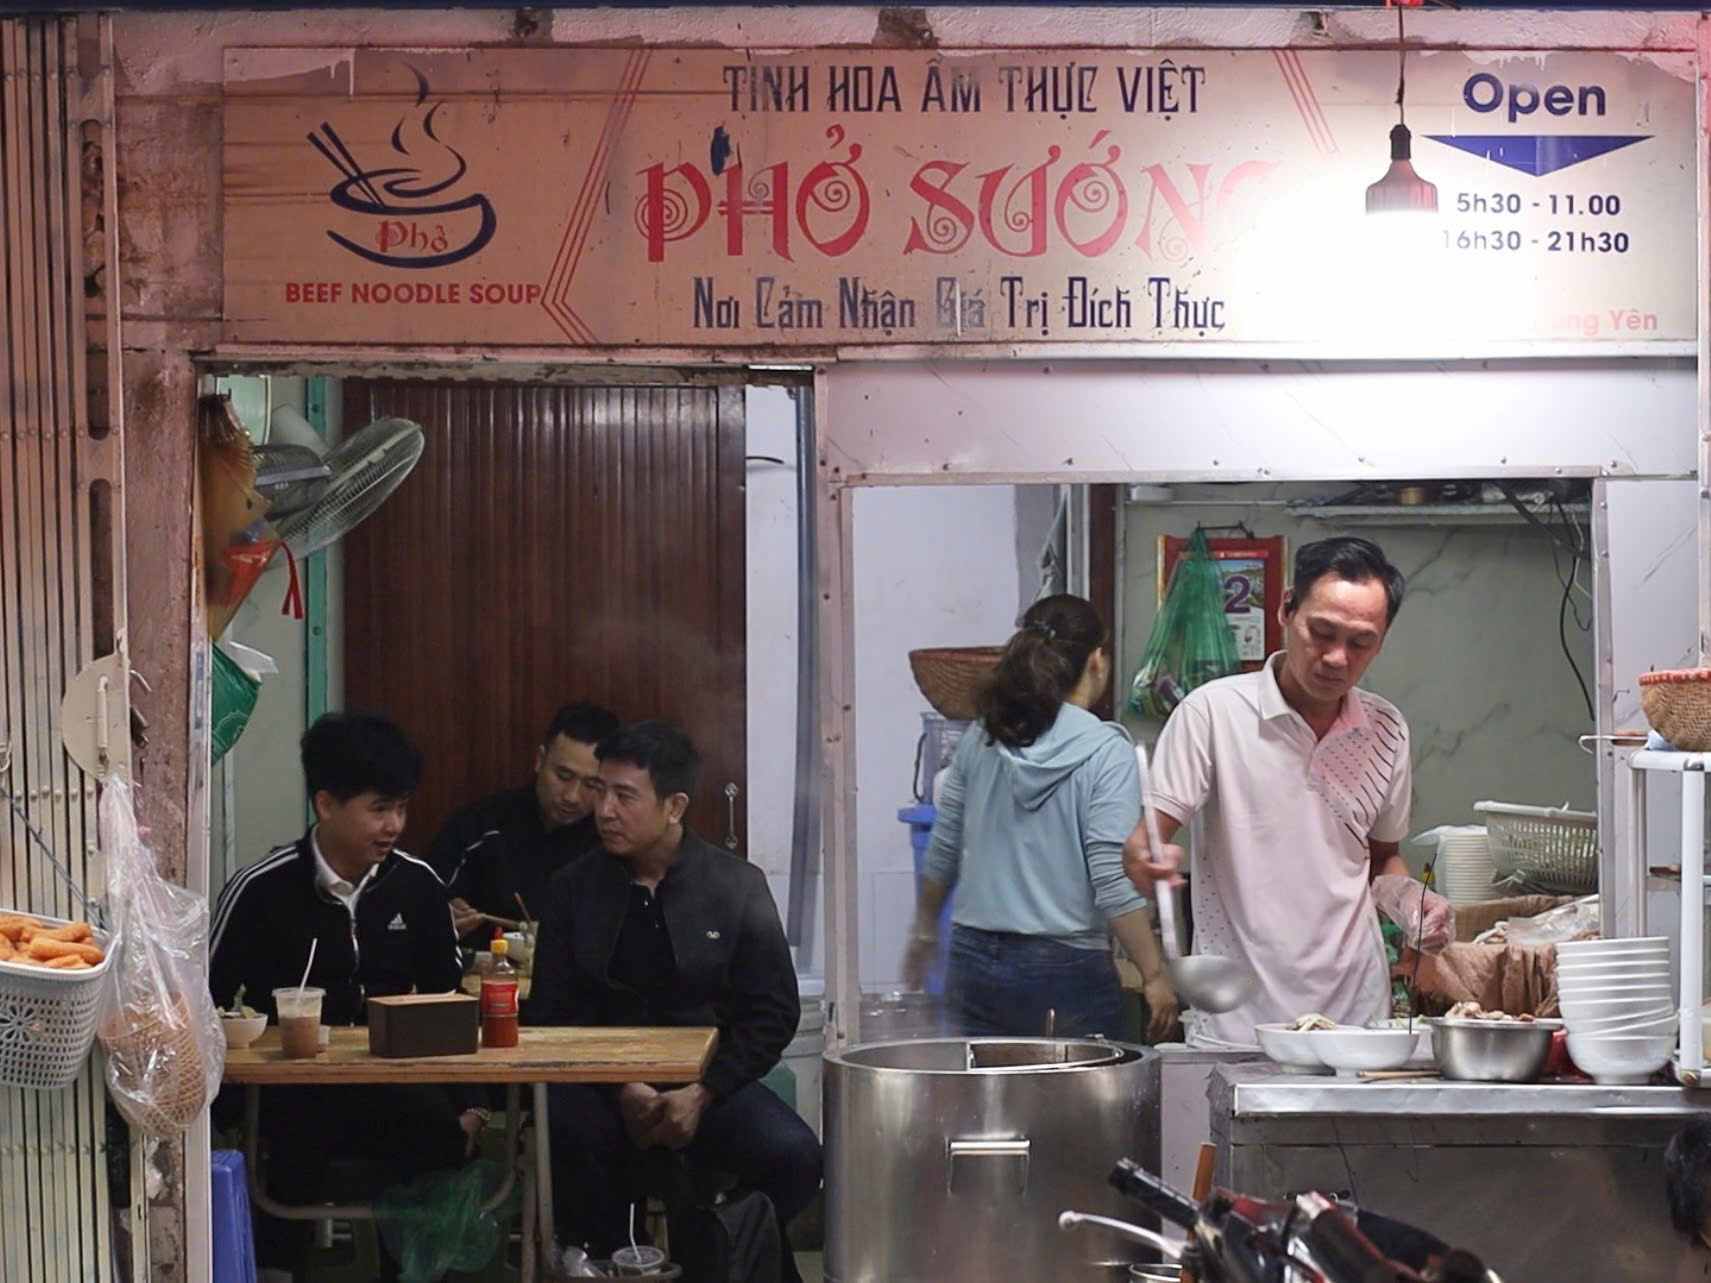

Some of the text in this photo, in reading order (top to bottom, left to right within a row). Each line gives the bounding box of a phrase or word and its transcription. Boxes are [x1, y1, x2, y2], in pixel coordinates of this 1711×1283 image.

[722, 65, 810, 112] TINH
[826, 65, 902, 112] HOA
[998, 61, 1098, 120] THỰC
[1116, 58, 1206, 121] VIỆT
[1463, 72, 1607, 122] Open
[635, 124, 870, 262] PHỞ
[1457, 193, 1522, 214] 5h30
[1549, 194, 1621, 216] 11.00
[375, 220, 448, 252] Phở
[1547, 231, 1630, 254] 21h30
[285, 283, 541, 304] BEEF NOODLE SOUP
[693, 276, 740, 329] Nơi
[756, 276, 824, 330] Cảm
[839, 276, 916, 337] Nhận
[1000, 276, 1050, 336] Trị
[1062, 276, 1131, 329] Đích
[1148, 277, 1226, 337] Thực
[1608, 307, 1658, 331] Yên
